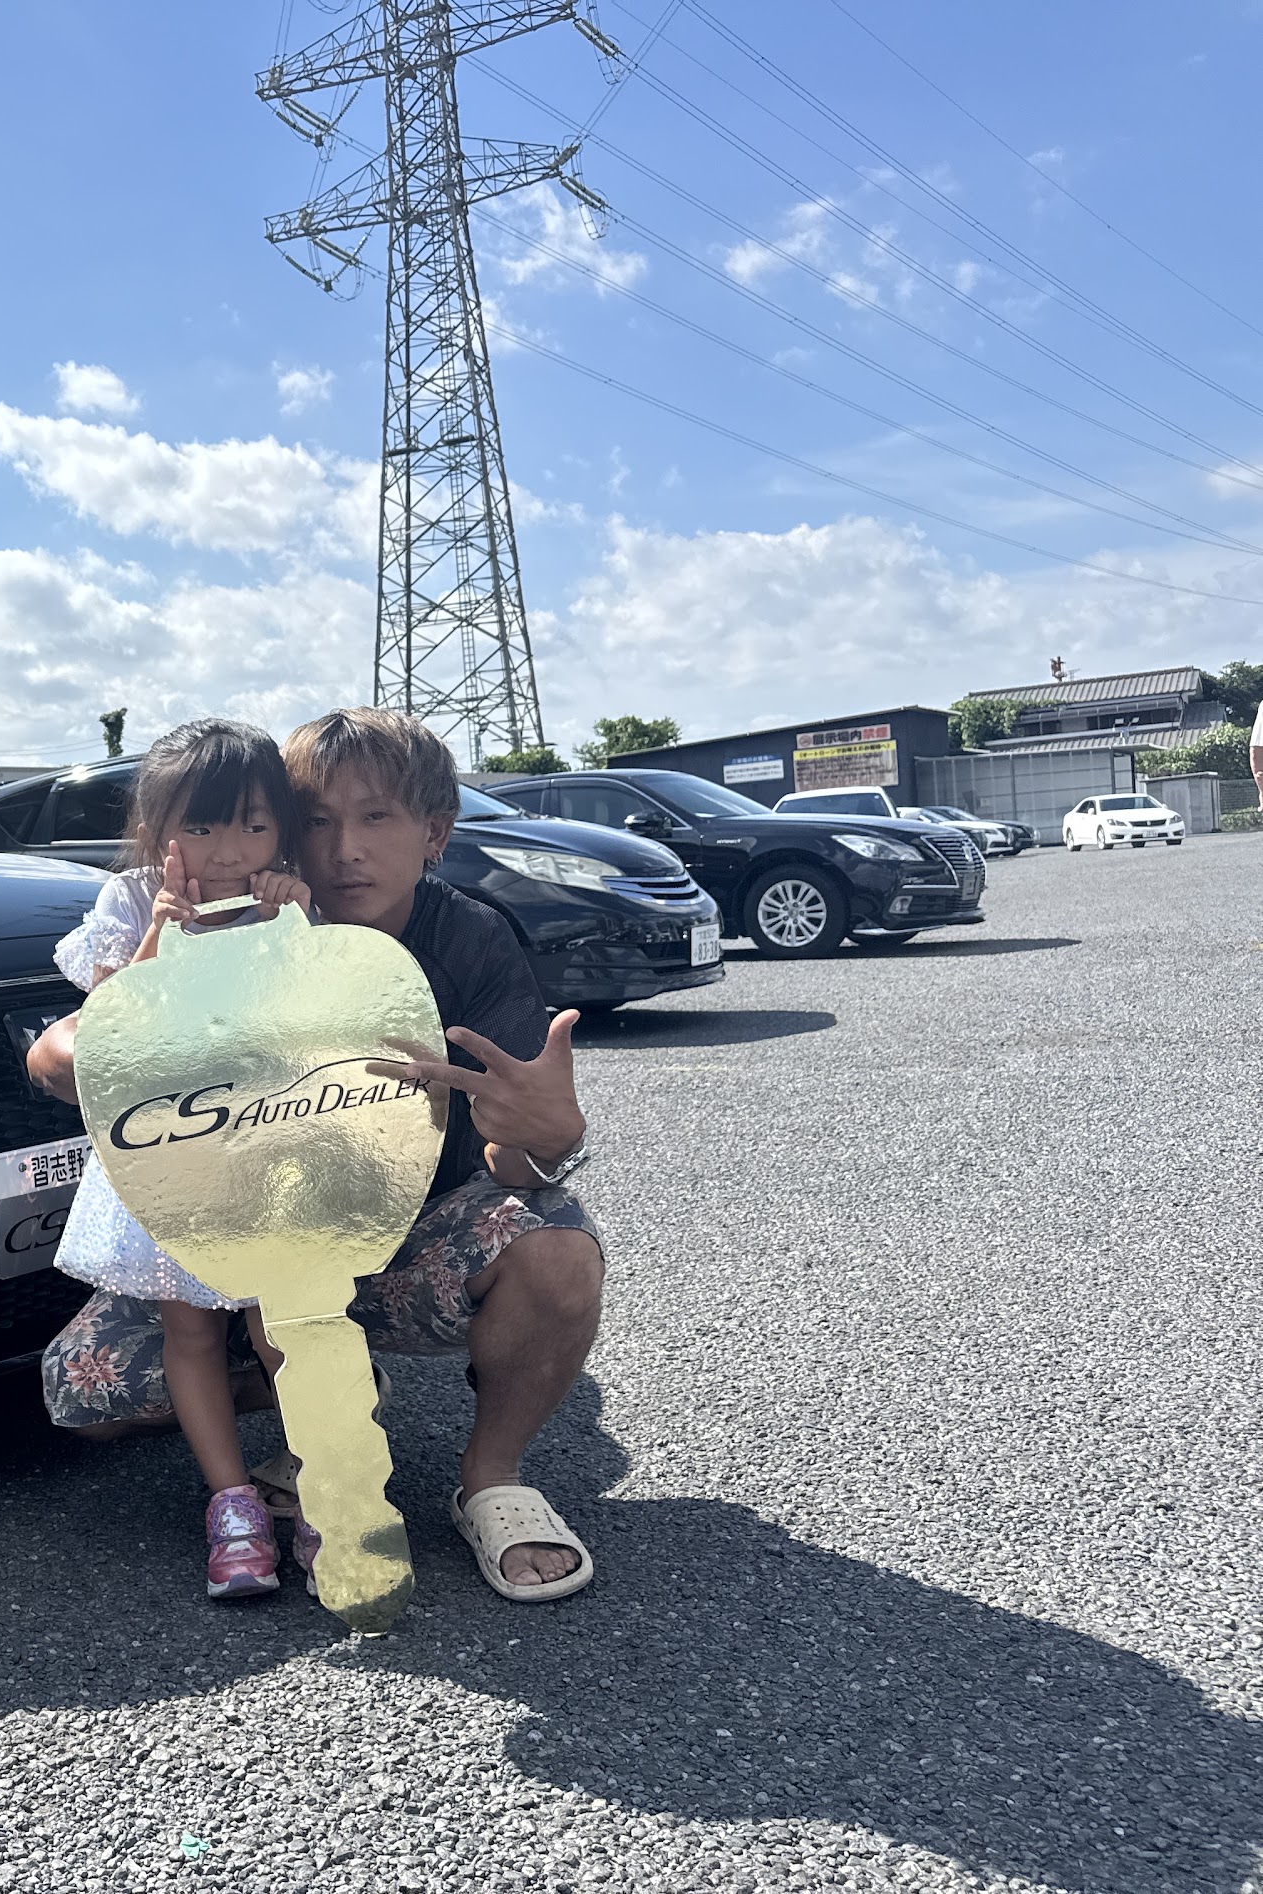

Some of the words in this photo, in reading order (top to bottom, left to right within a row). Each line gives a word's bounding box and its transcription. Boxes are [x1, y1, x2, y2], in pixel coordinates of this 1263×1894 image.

[109, 1081, 234, 1150] CS
[31, 1147, 85, 1188] 習志野
[4, 1206, 72, 1254] CS
